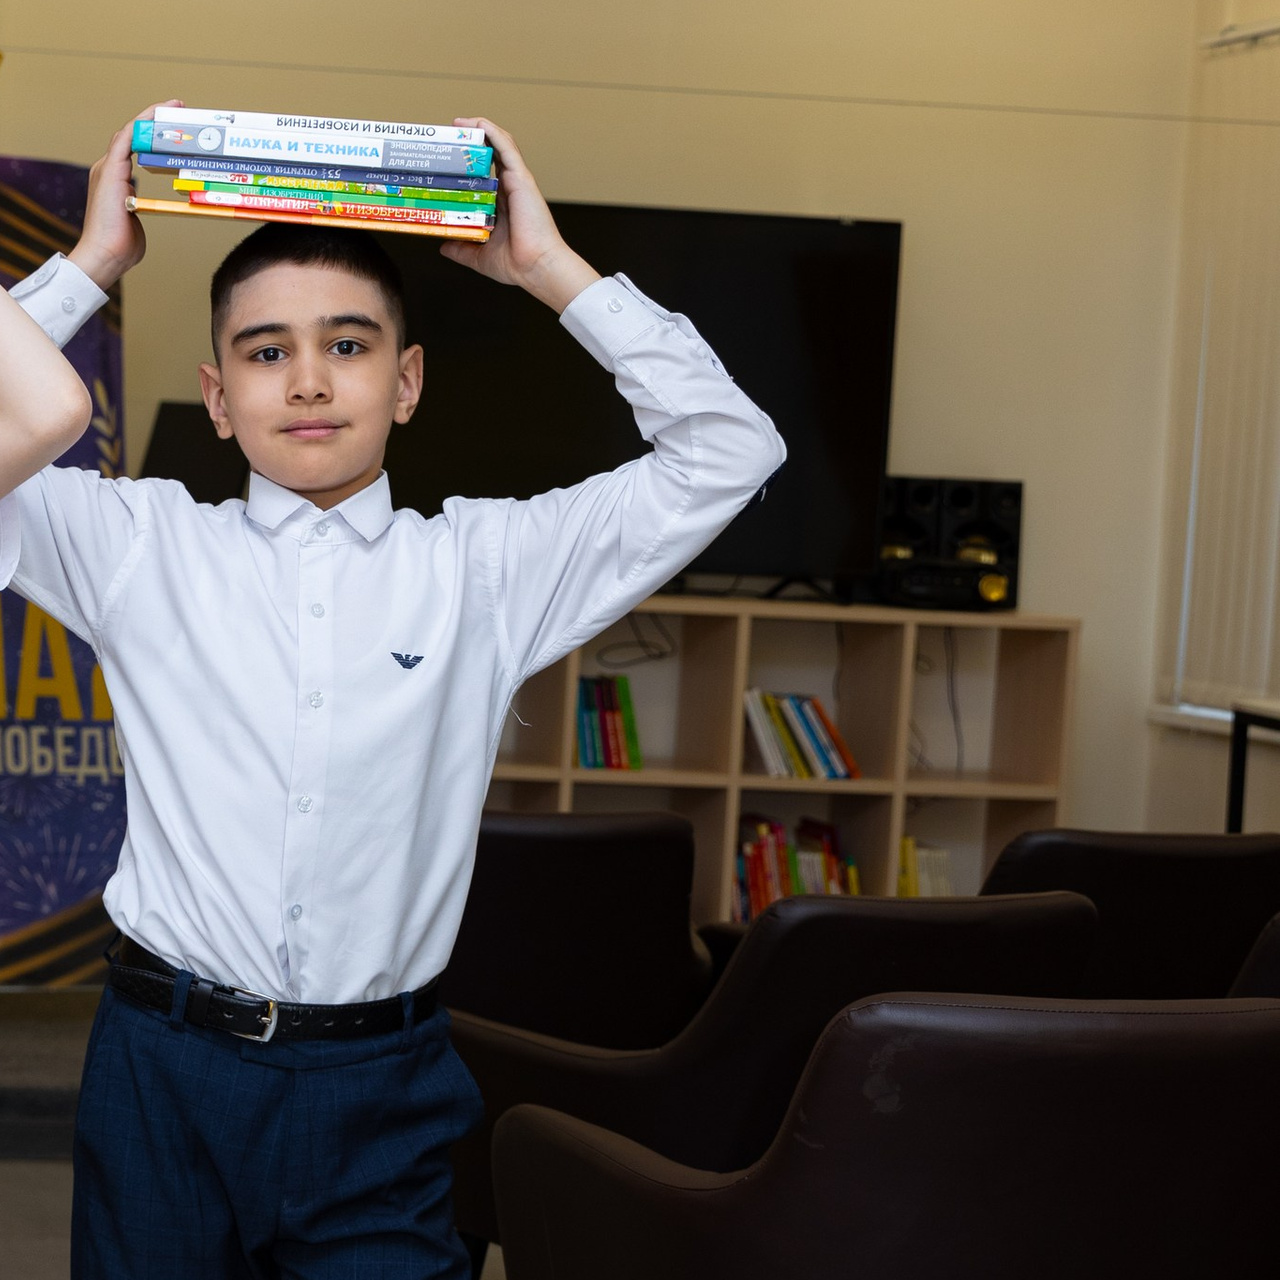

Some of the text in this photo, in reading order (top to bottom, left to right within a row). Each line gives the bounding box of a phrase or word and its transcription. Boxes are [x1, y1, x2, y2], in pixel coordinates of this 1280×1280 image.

[276, 117, 436, 137] ОТКРЫТИЯ И ИЗОБРЕТЕНИЯ
[229, 136, 380, 158] НАУКА И ТЕХНИКА
[390, 142, 452, 153] ЭНЦИКЛОПЕДИЯ
[389, 151, 437, 160] ЗАНИМАТЕЛЬНЫХ
[166, 157, 186, 166] МИР
[187, 159, 234, 171] ИЗМЕНИЛИ
[388, 158, 430, 168] ДЛЯ ДЕТЕЙ
[235, 163, 272, 174] КОТОРЫЕ
[238, 186, 325, 201] МИР ИЗОБРЕТЕНИЙ
[243, 197, 309, 211] ОТКРЫТИЯ
[346, 204, 355, 213] И
[356, 204, 443, 221] ИЗОБРЕТЕНИЯ
